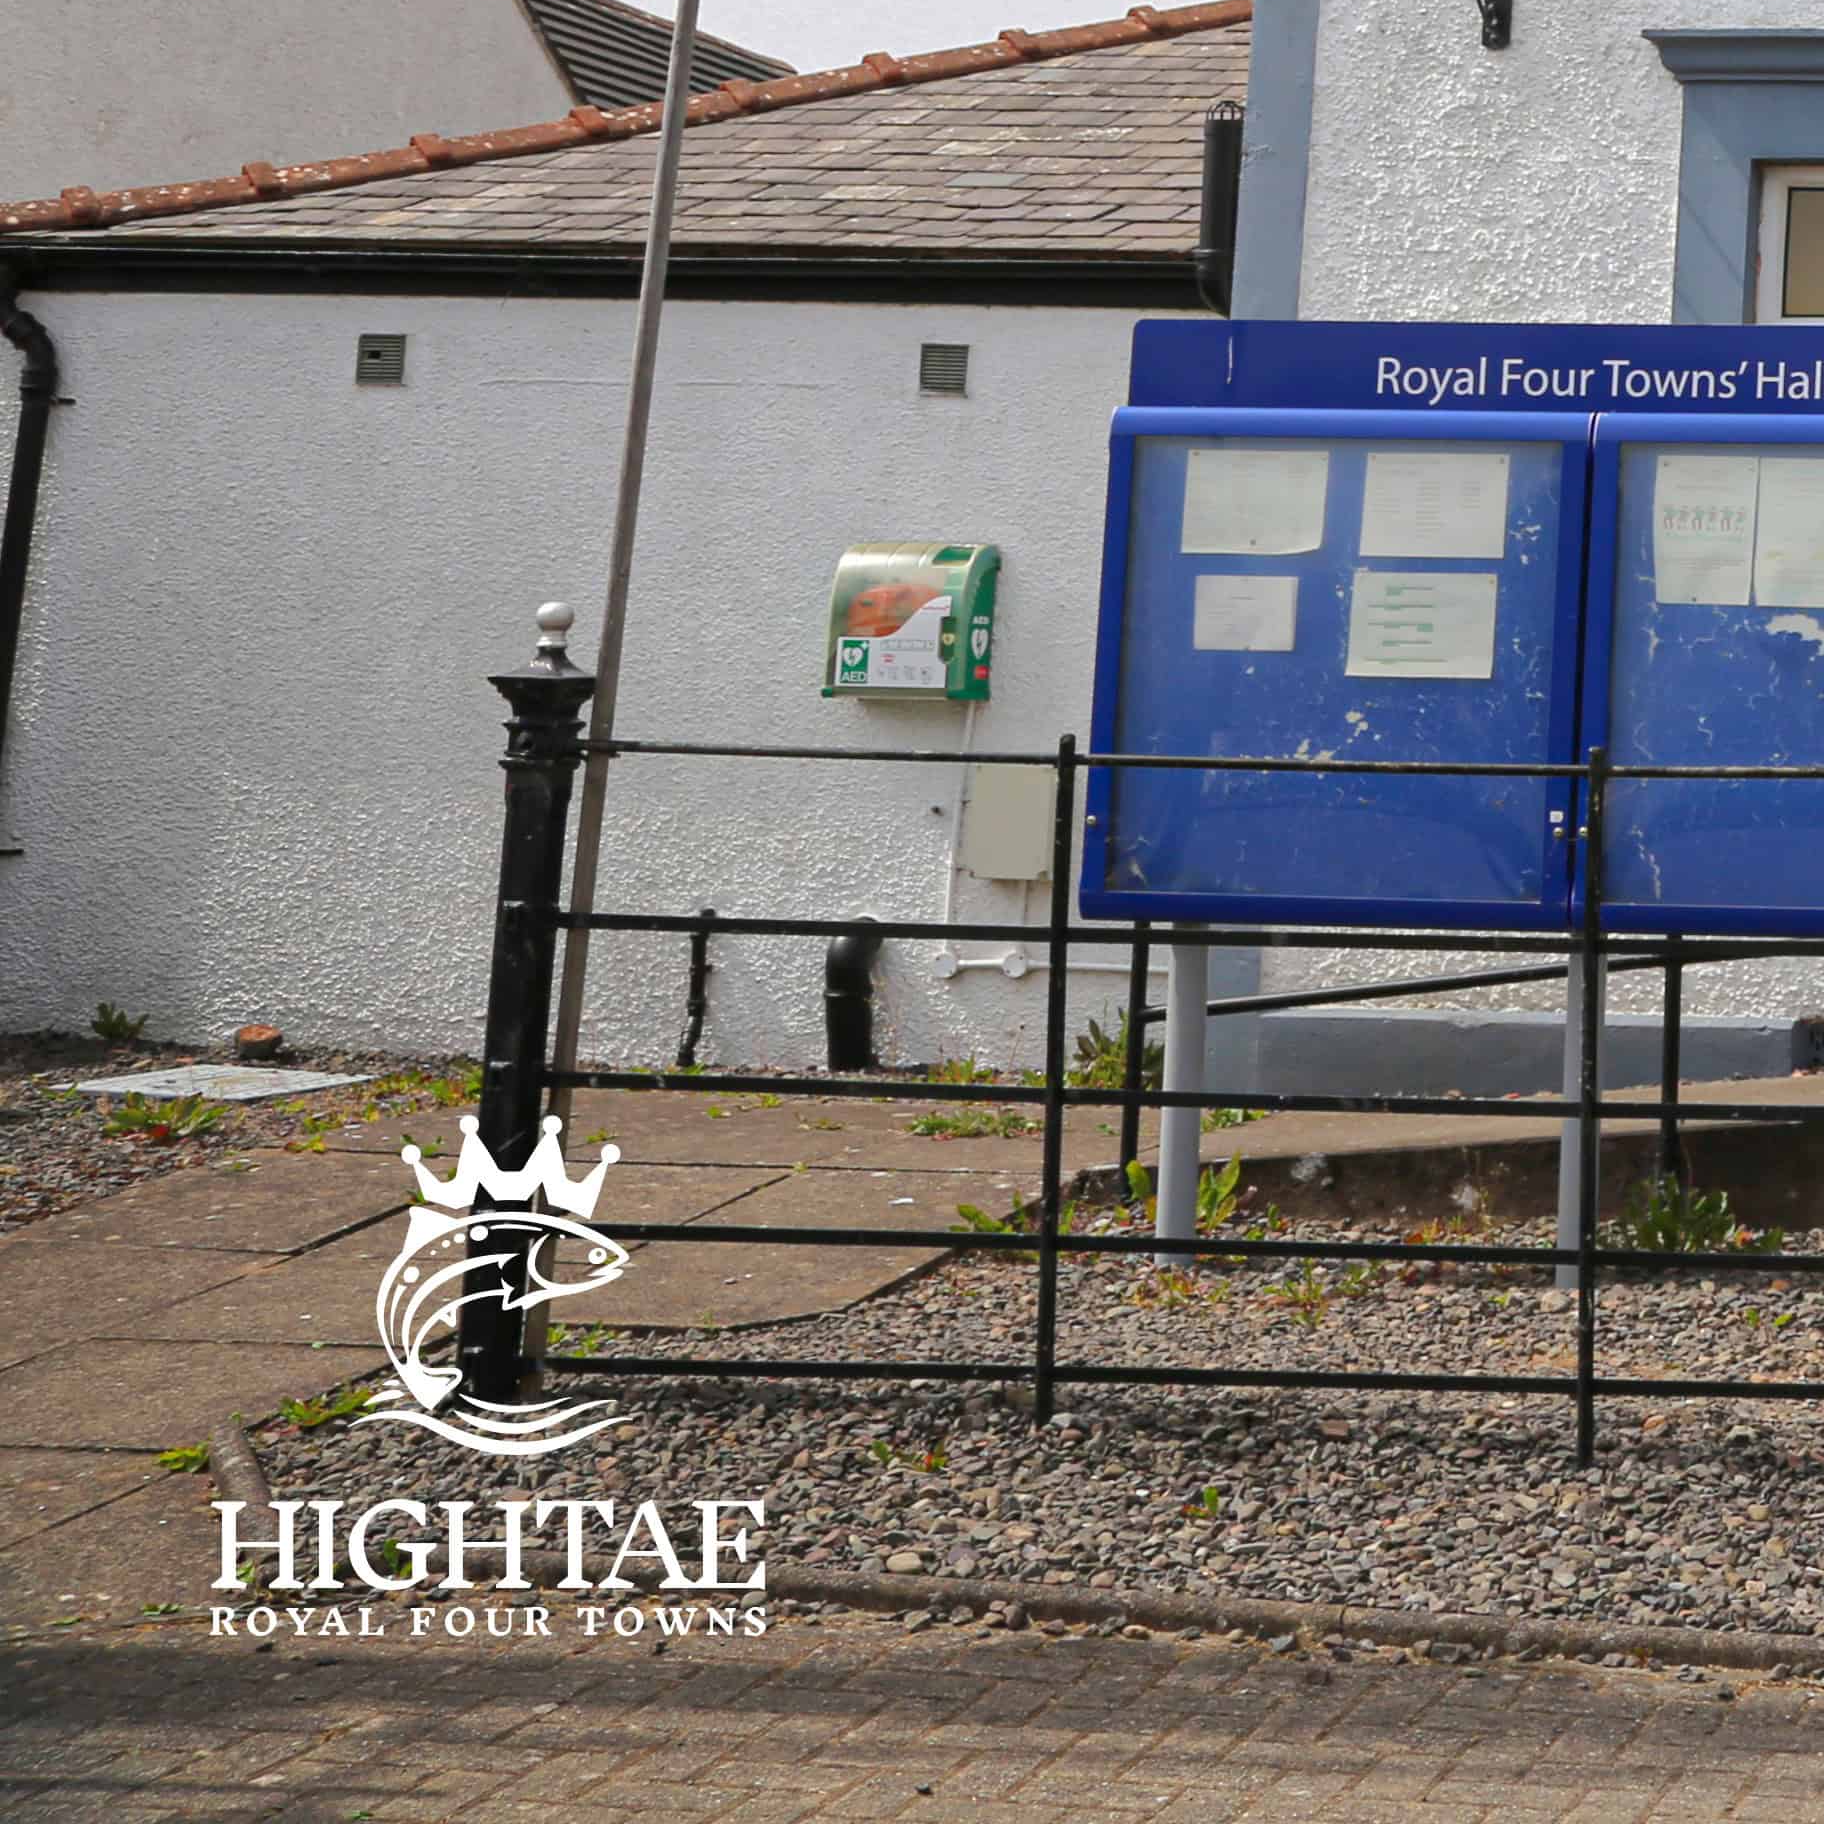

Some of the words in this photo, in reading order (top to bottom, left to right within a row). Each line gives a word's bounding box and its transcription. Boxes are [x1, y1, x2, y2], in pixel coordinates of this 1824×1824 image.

[1375, 357, 1488, 406] Royal
[1501, 359, 1595, 398] Four
[841, 671, 867, 683] AED
